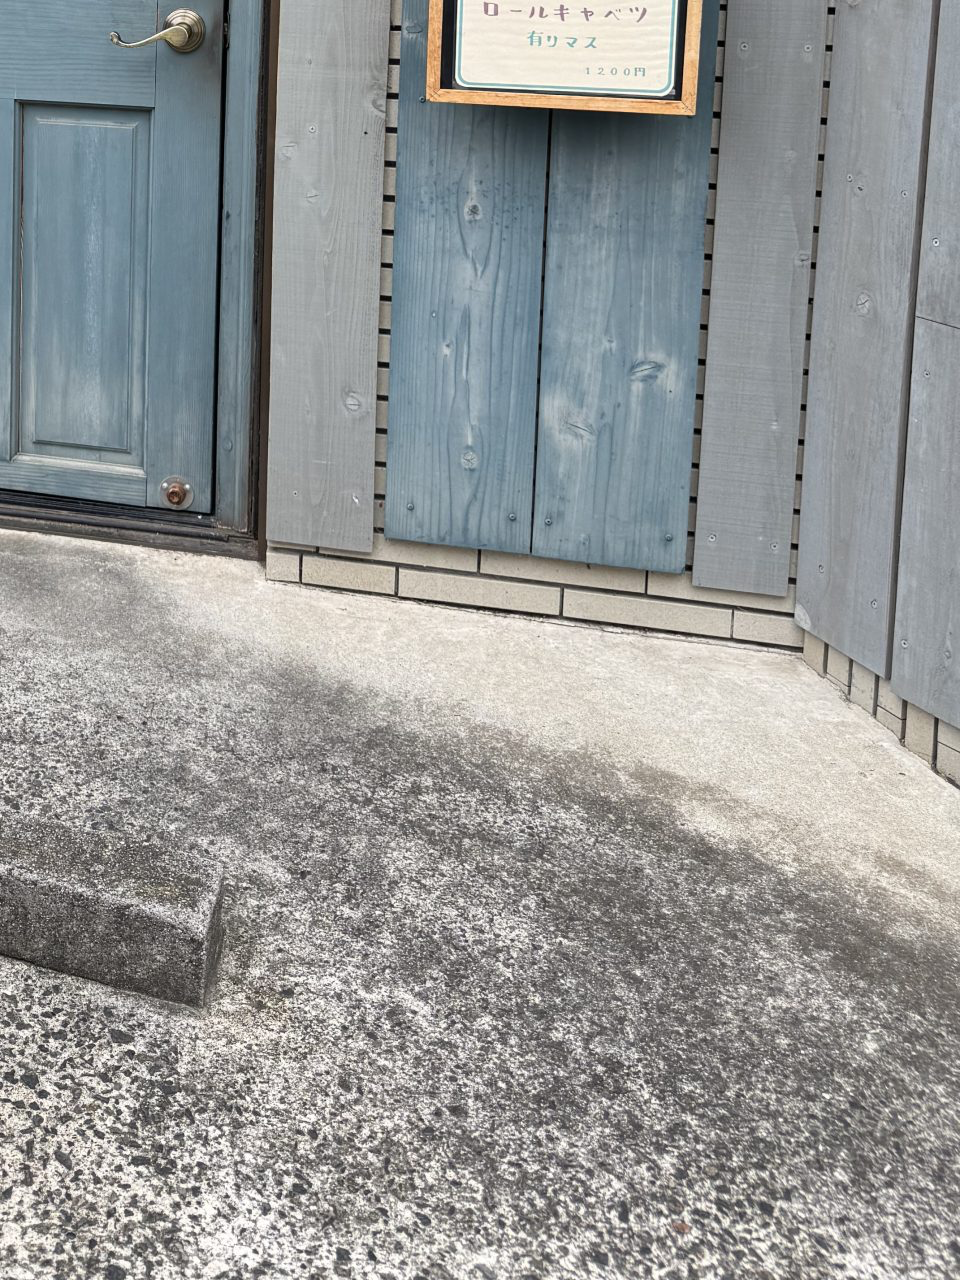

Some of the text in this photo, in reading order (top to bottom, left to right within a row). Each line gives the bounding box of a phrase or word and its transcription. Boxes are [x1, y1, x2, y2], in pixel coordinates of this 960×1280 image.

[483, 1, 648, 23] ロールキャベツ
[585, 66, 646, 77] 1200円
